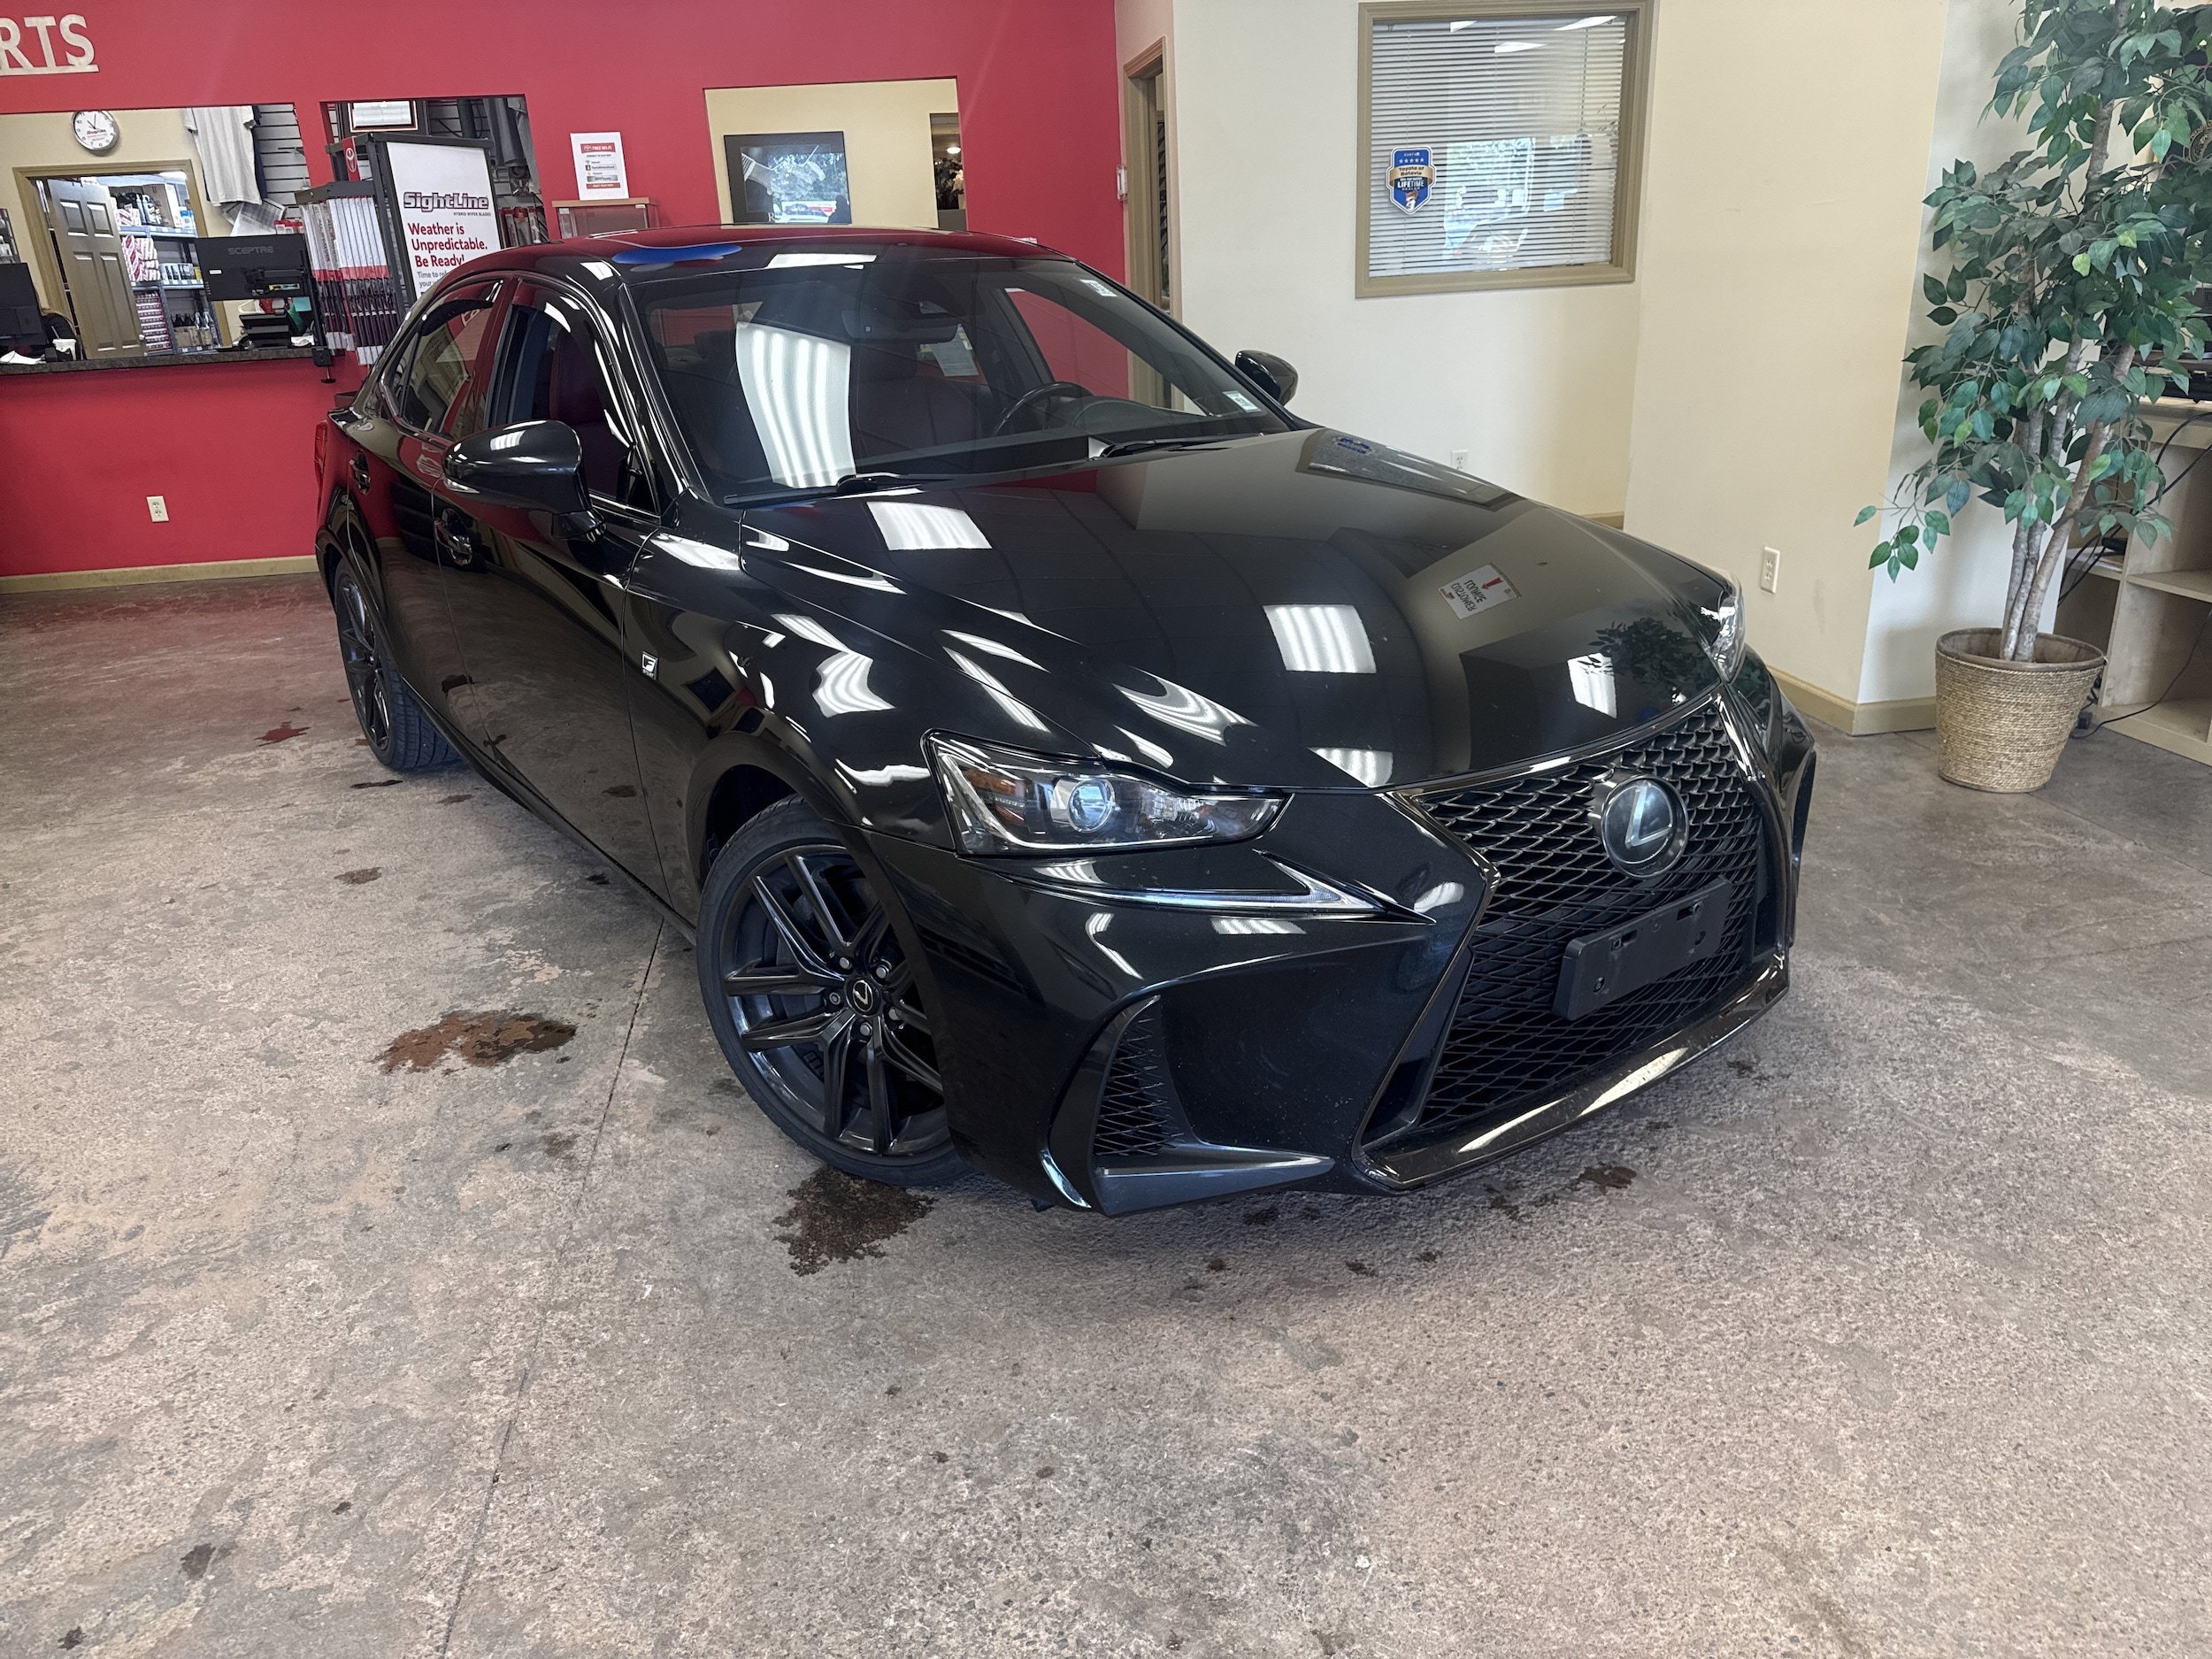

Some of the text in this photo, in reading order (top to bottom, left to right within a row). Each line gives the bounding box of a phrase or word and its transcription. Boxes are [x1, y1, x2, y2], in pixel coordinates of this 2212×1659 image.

[403, 191, 489, 212] SightLine
[407, 221, 465, 235] Weather is
[227, 245, 275, 256] SCEPTRE
[411, 237, 488, 254] Unpredictable.
[414, 255, 429, 267] Be
[419, 280, 432, 289] your
